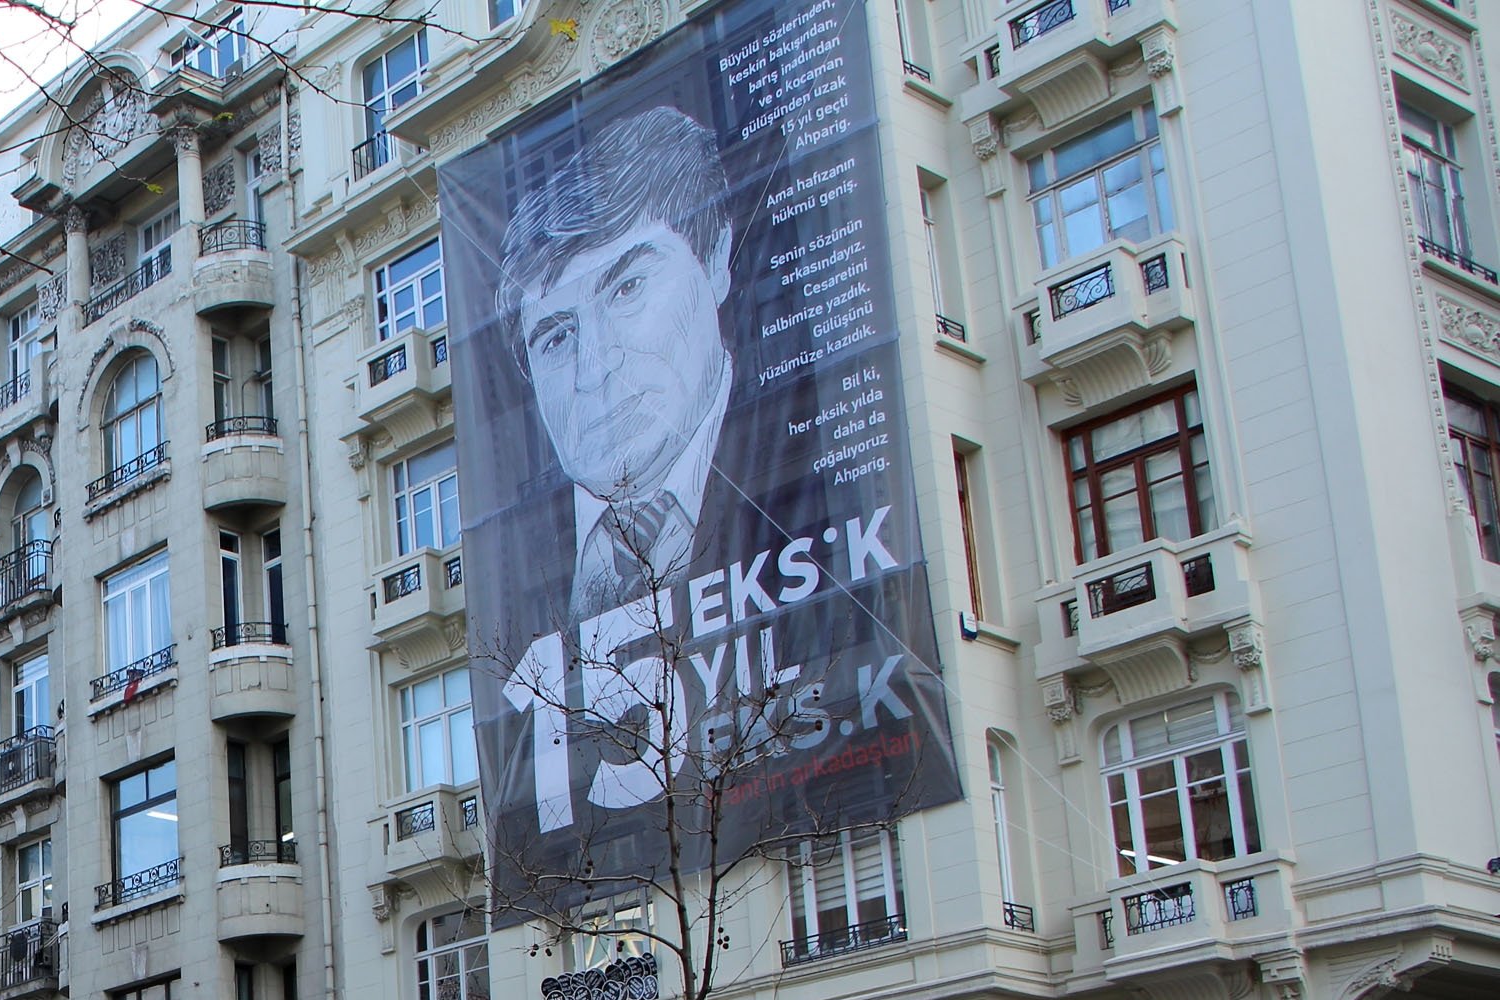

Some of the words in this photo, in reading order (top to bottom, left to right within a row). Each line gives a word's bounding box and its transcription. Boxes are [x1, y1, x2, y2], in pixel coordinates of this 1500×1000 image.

[719, 40, 760, 73] Büyülü
[762, 0, 836, 48] sözlerinden,
[728, 58, 767, 87] keskin
[769, 18, 838, 63] bakışından,
[748, 70, 779, 95] barış
[781, 36, 841, 77] inadından
[758, 94, 773, 108] ve
[775, 87, 783, 99] o
[785, 56, 844, 92] kocaman
[741, 92, 811, 141] gülüşünden
[814, 74, 847, 98] uzak
[780, 122, 795, 137] 15
[797, 109, 813, 131] yıl
[815, 93, 849, 121] geçti
[795, 118, 851, 150] Ahparig.
[766, 187, 794, 209] Ama
[796, 157, 856, 193] hafızanın
[772, 197, 816, 227] hükmü
[819, 178, 858, 207] geniş.
[770, 246, 806, 270] Senin
[808, 218, 863, 250] sözünün
[780, 242, 866, 287] arkasındayız.
[803, 257, 868, 298] Cesaretini
[761, 304, 823, 339] kalbimize
[825, 282, 871, 313] yazdık.
[812, 300, 874, 339] Gülüşünü
[758, 348, 823, 387] yüzümüze
[826, 324, 876, 355] kazıdık.
[842, 374, 861, 391] Bil
[863, 366, 880, 384] ki,
[788, 420, 811, 436] her
[815, 401, 849, 427] eksik
[851, 388, 883, 416] yılda
[833, 418, 865, 441] daha
[868, 409, 886, 429] da
[813, 432, 889, 474] çoğalıyoruz
[833, 456, 891, 487] Ahparig.
[689, 626, 800, 707] YIL
[502, 588, 688, 834] 15
